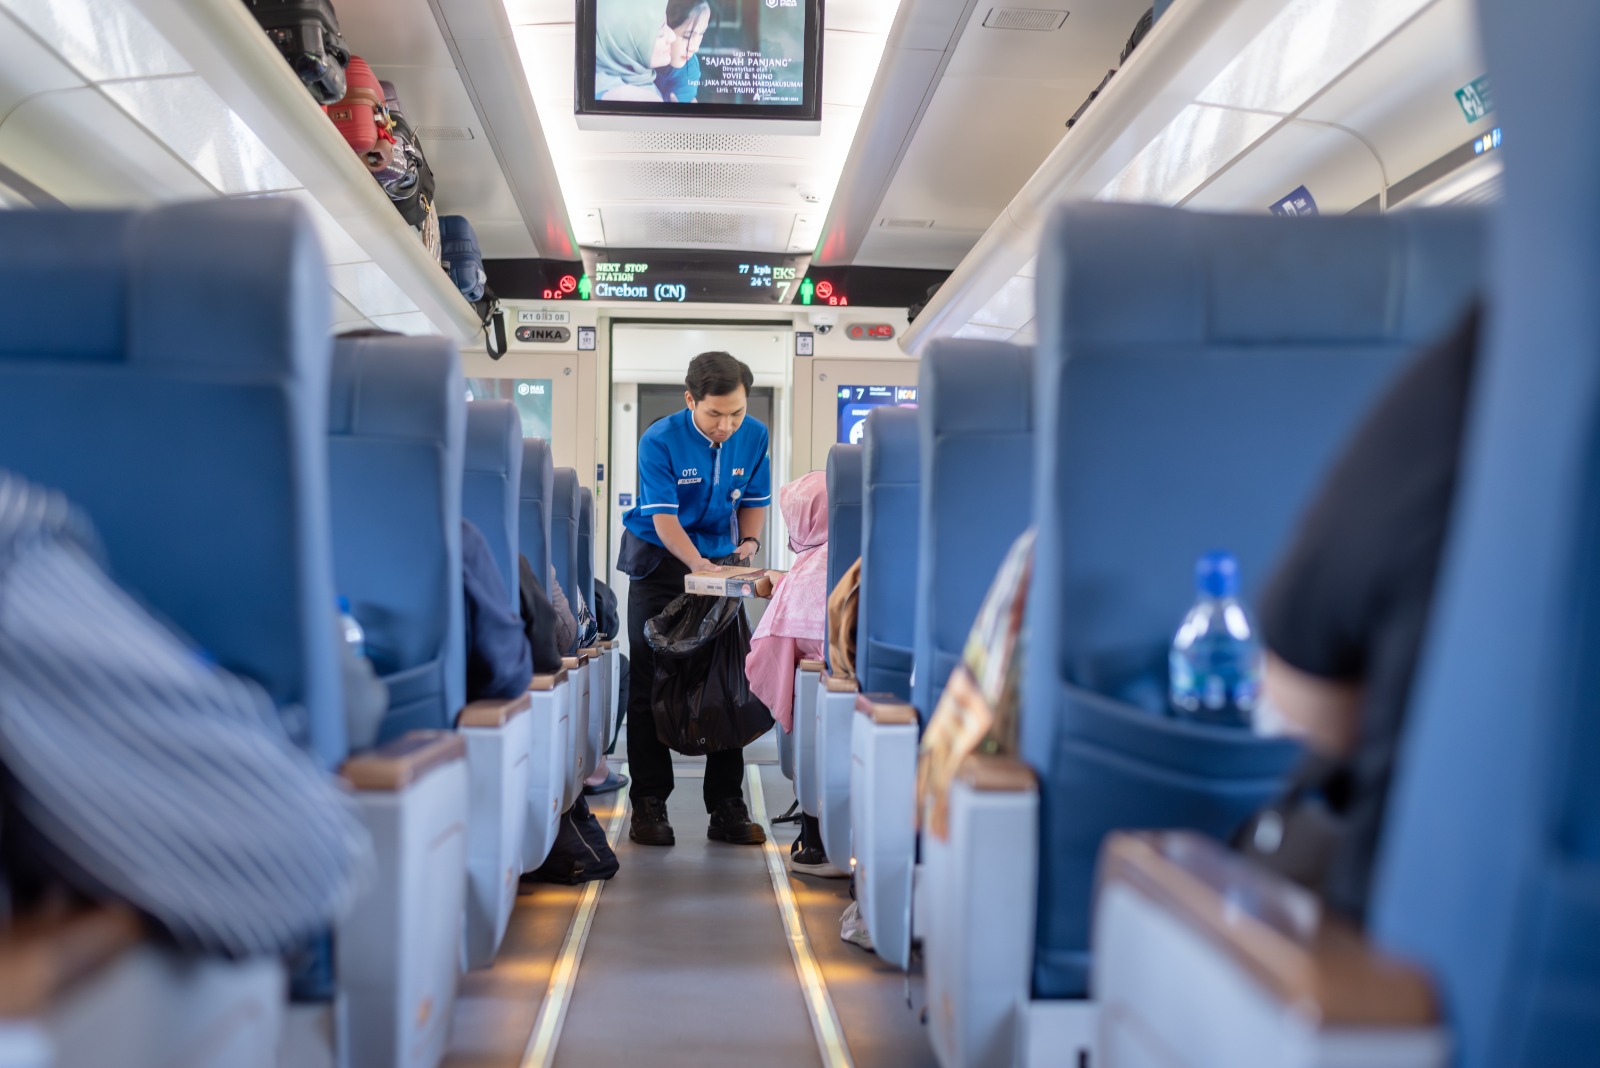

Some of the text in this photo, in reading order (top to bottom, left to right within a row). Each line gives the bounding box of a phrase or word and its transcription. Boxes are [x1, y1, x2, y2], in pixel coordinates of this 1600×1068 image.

[596, 263, 648, 272] NEXT STOP
[739, 265, 771, 275] 77 kph
[596, 273, 634, 282] STATION
[773, 267, 795, 280] EKS
[595, 283, 686, 301] Cirebon (CN)
[777, 282, 791, 303] 7
[532, 330, 562, 339] INKA
[856, 388, 864, 400] 7
[898, 390, 916, 400] KAI
[682, 468, 697, 477] OTC
[732, 468, 744, 476] KAI
